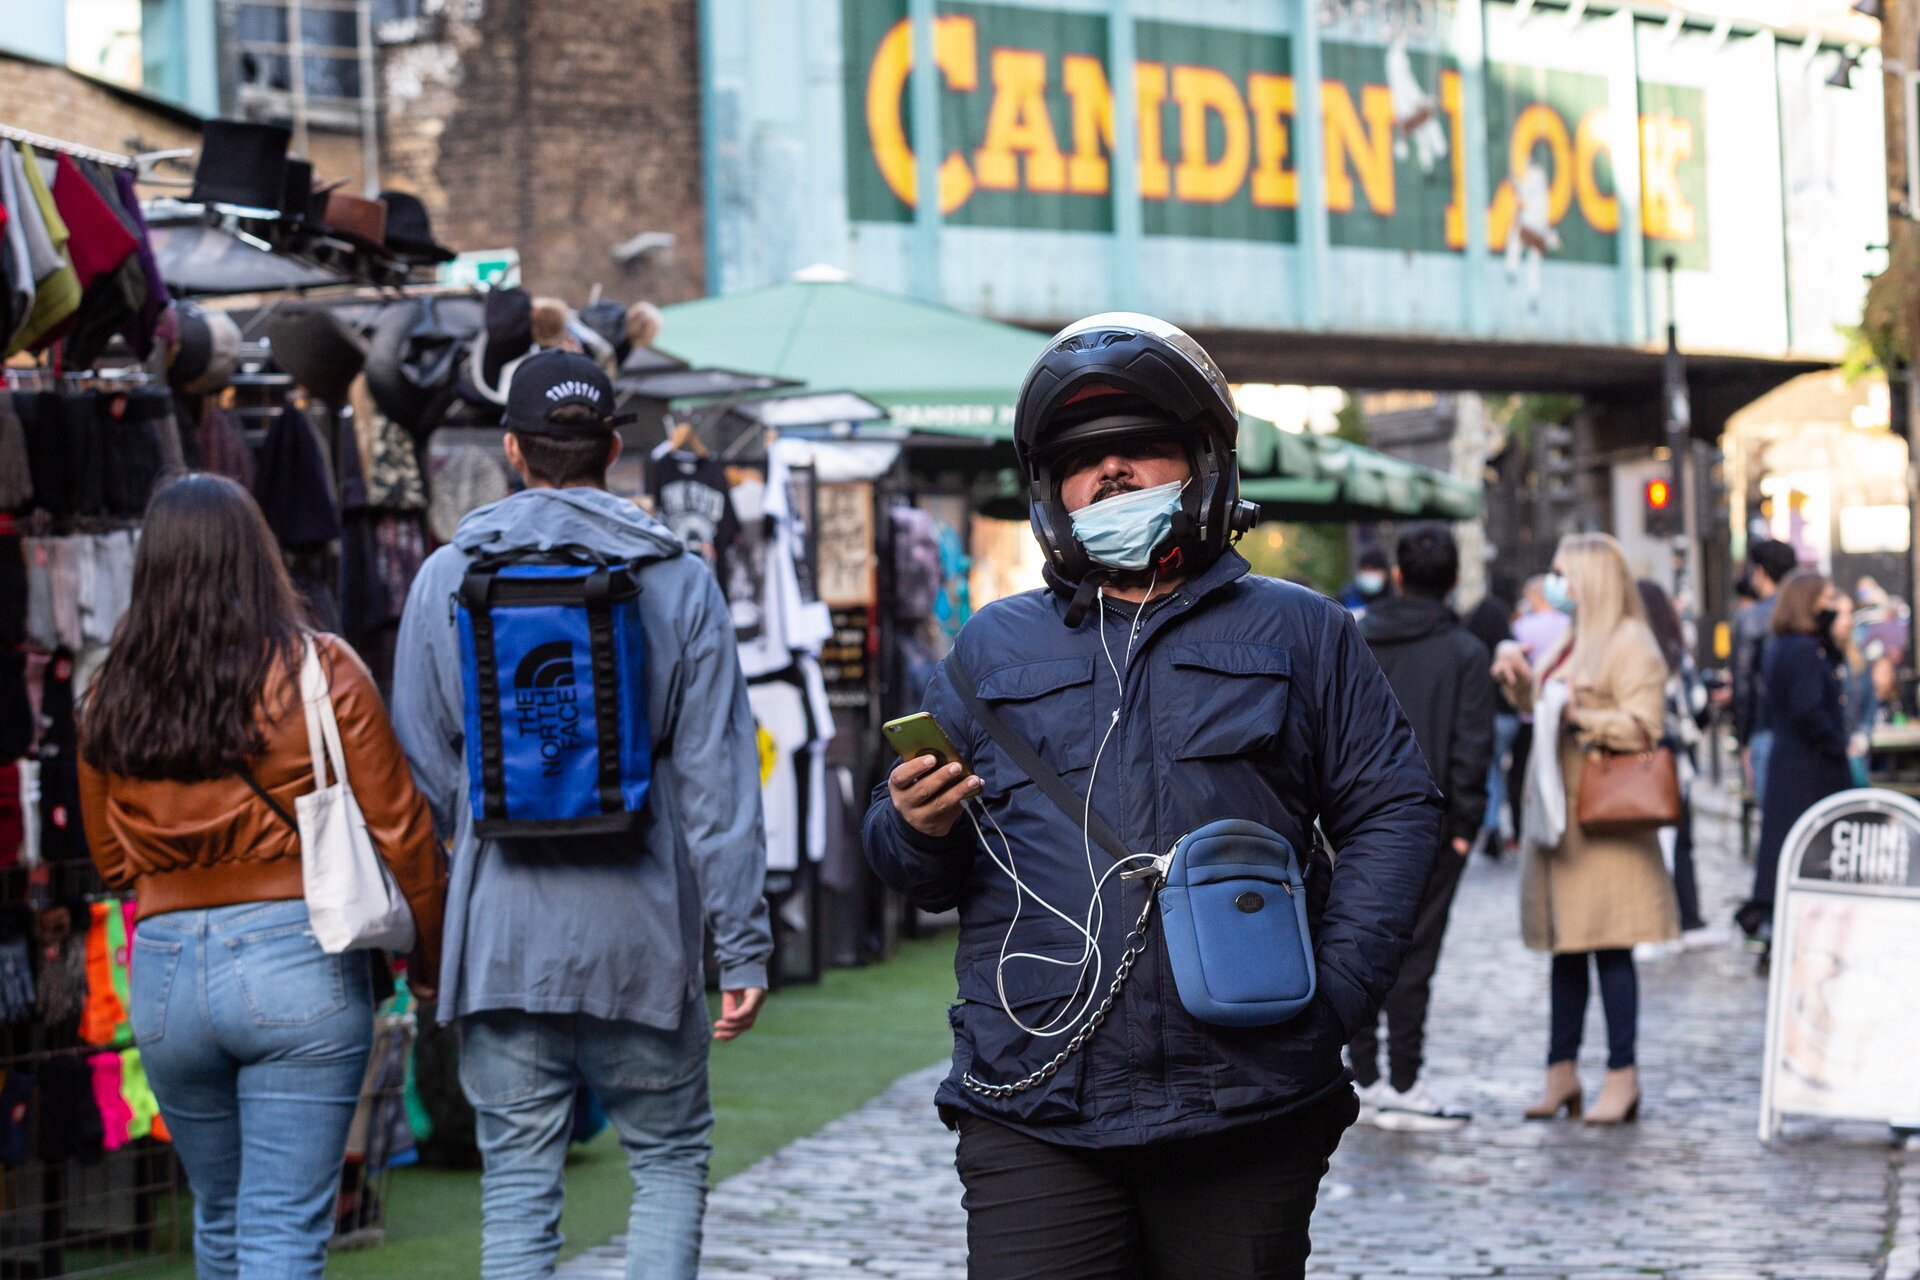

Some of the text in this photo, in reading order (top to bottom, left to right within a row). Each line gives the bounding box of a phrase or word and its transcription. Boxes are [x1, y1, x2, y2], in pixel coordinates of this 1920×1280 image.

[866, 13, 1396, 218] CAMDEN
[545, 380, 601, 402] TRAPSTAR
[516, 689, 537, 738] THE
[538, 689, 561, 777] NORTH
[557, 687, 580, 750] FACE
